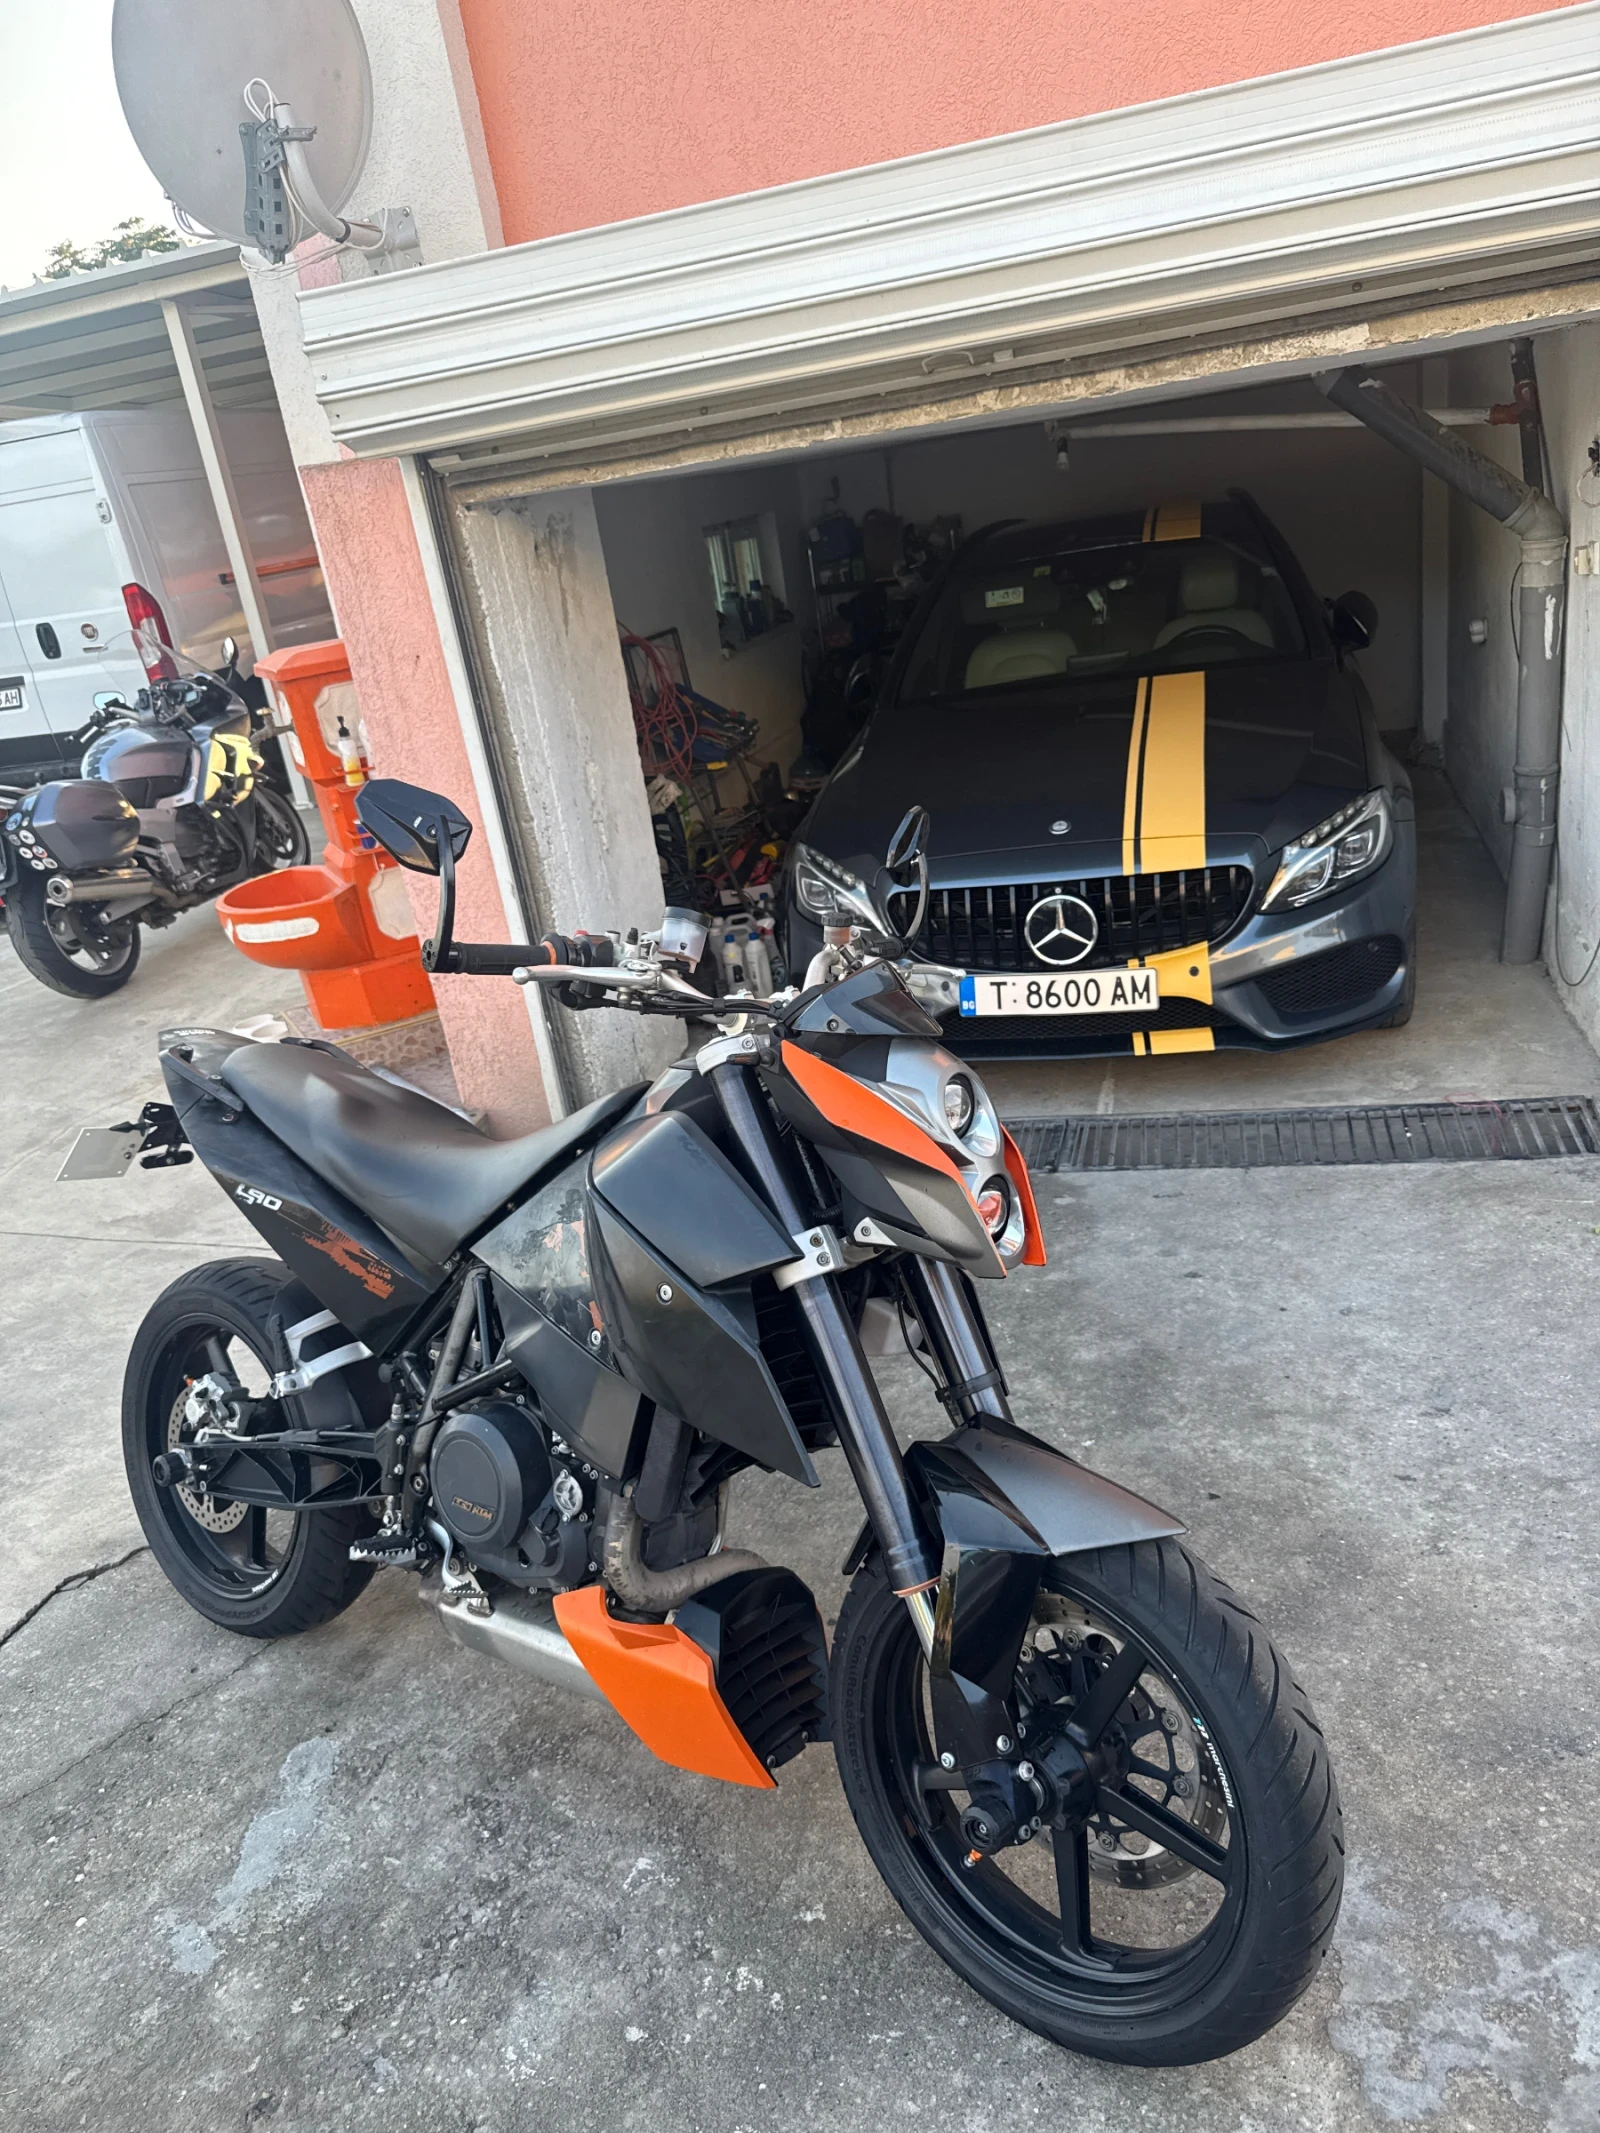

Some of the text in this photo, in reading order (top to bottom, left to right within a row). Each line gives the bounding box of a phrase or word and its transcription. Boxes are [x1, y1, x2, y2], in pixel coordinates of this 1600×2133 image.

[962, 1000, 976, 1010] BG
[1026, 978, 1101, 1009] 8600
[1110, 974, 1151, 1006] AM
[1206, 1742, 1235, 1808] marchesini
